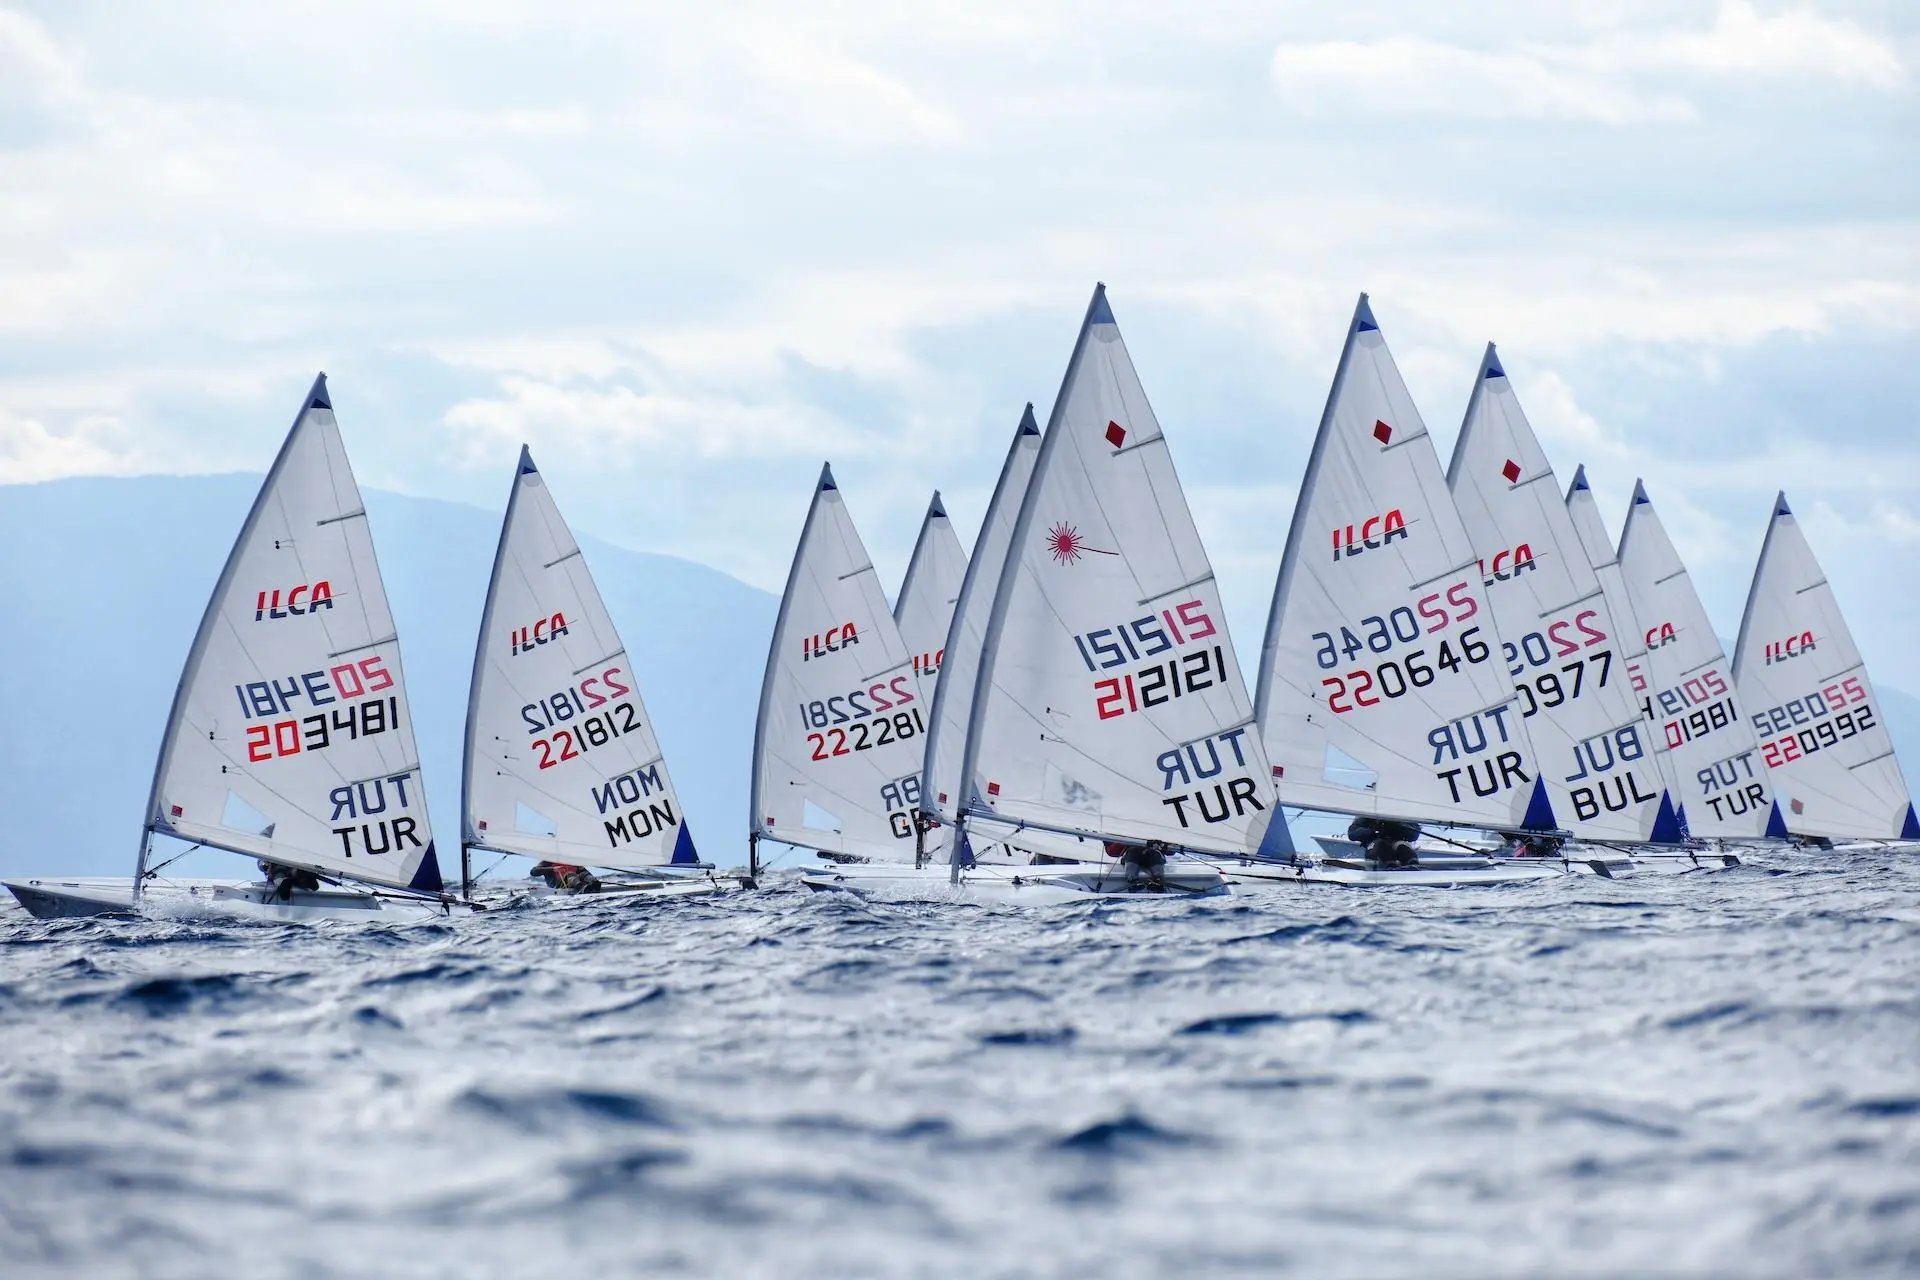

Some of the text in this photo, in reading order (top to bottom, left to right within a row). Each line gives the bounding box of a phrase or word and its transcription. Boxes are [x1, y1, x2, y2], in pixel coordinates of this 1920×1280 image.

[1332, 509, 1408, 562] ILCA
[255, 581, 334, 621] ILCA
[512, 612, 569, 656] ILCA
[804, 622, 859, 662] ILCA
[1765, 631, 1816, 666] ILCA
[1094, 645, 1227, 720] 212121
[1322, 626, 1490, 714] 220646
[247, 697, 398, 762] 203481
[531, 702, 642, 770] 221812
[807, 708, 925, 761] 222281
[1664, 698, 1737, 750] 01981
[1761, 704, 1876, 769] 220992
[1162, 777, 1266, 828] TUR
[1437, 751, 1531, 803] TUR
[1570, 771, 1657, 822] BUL
[1706, 782, 1769, 822] TUR
[332, 816, 422, 858] TUR
[604, 799, 677, 848] MON
